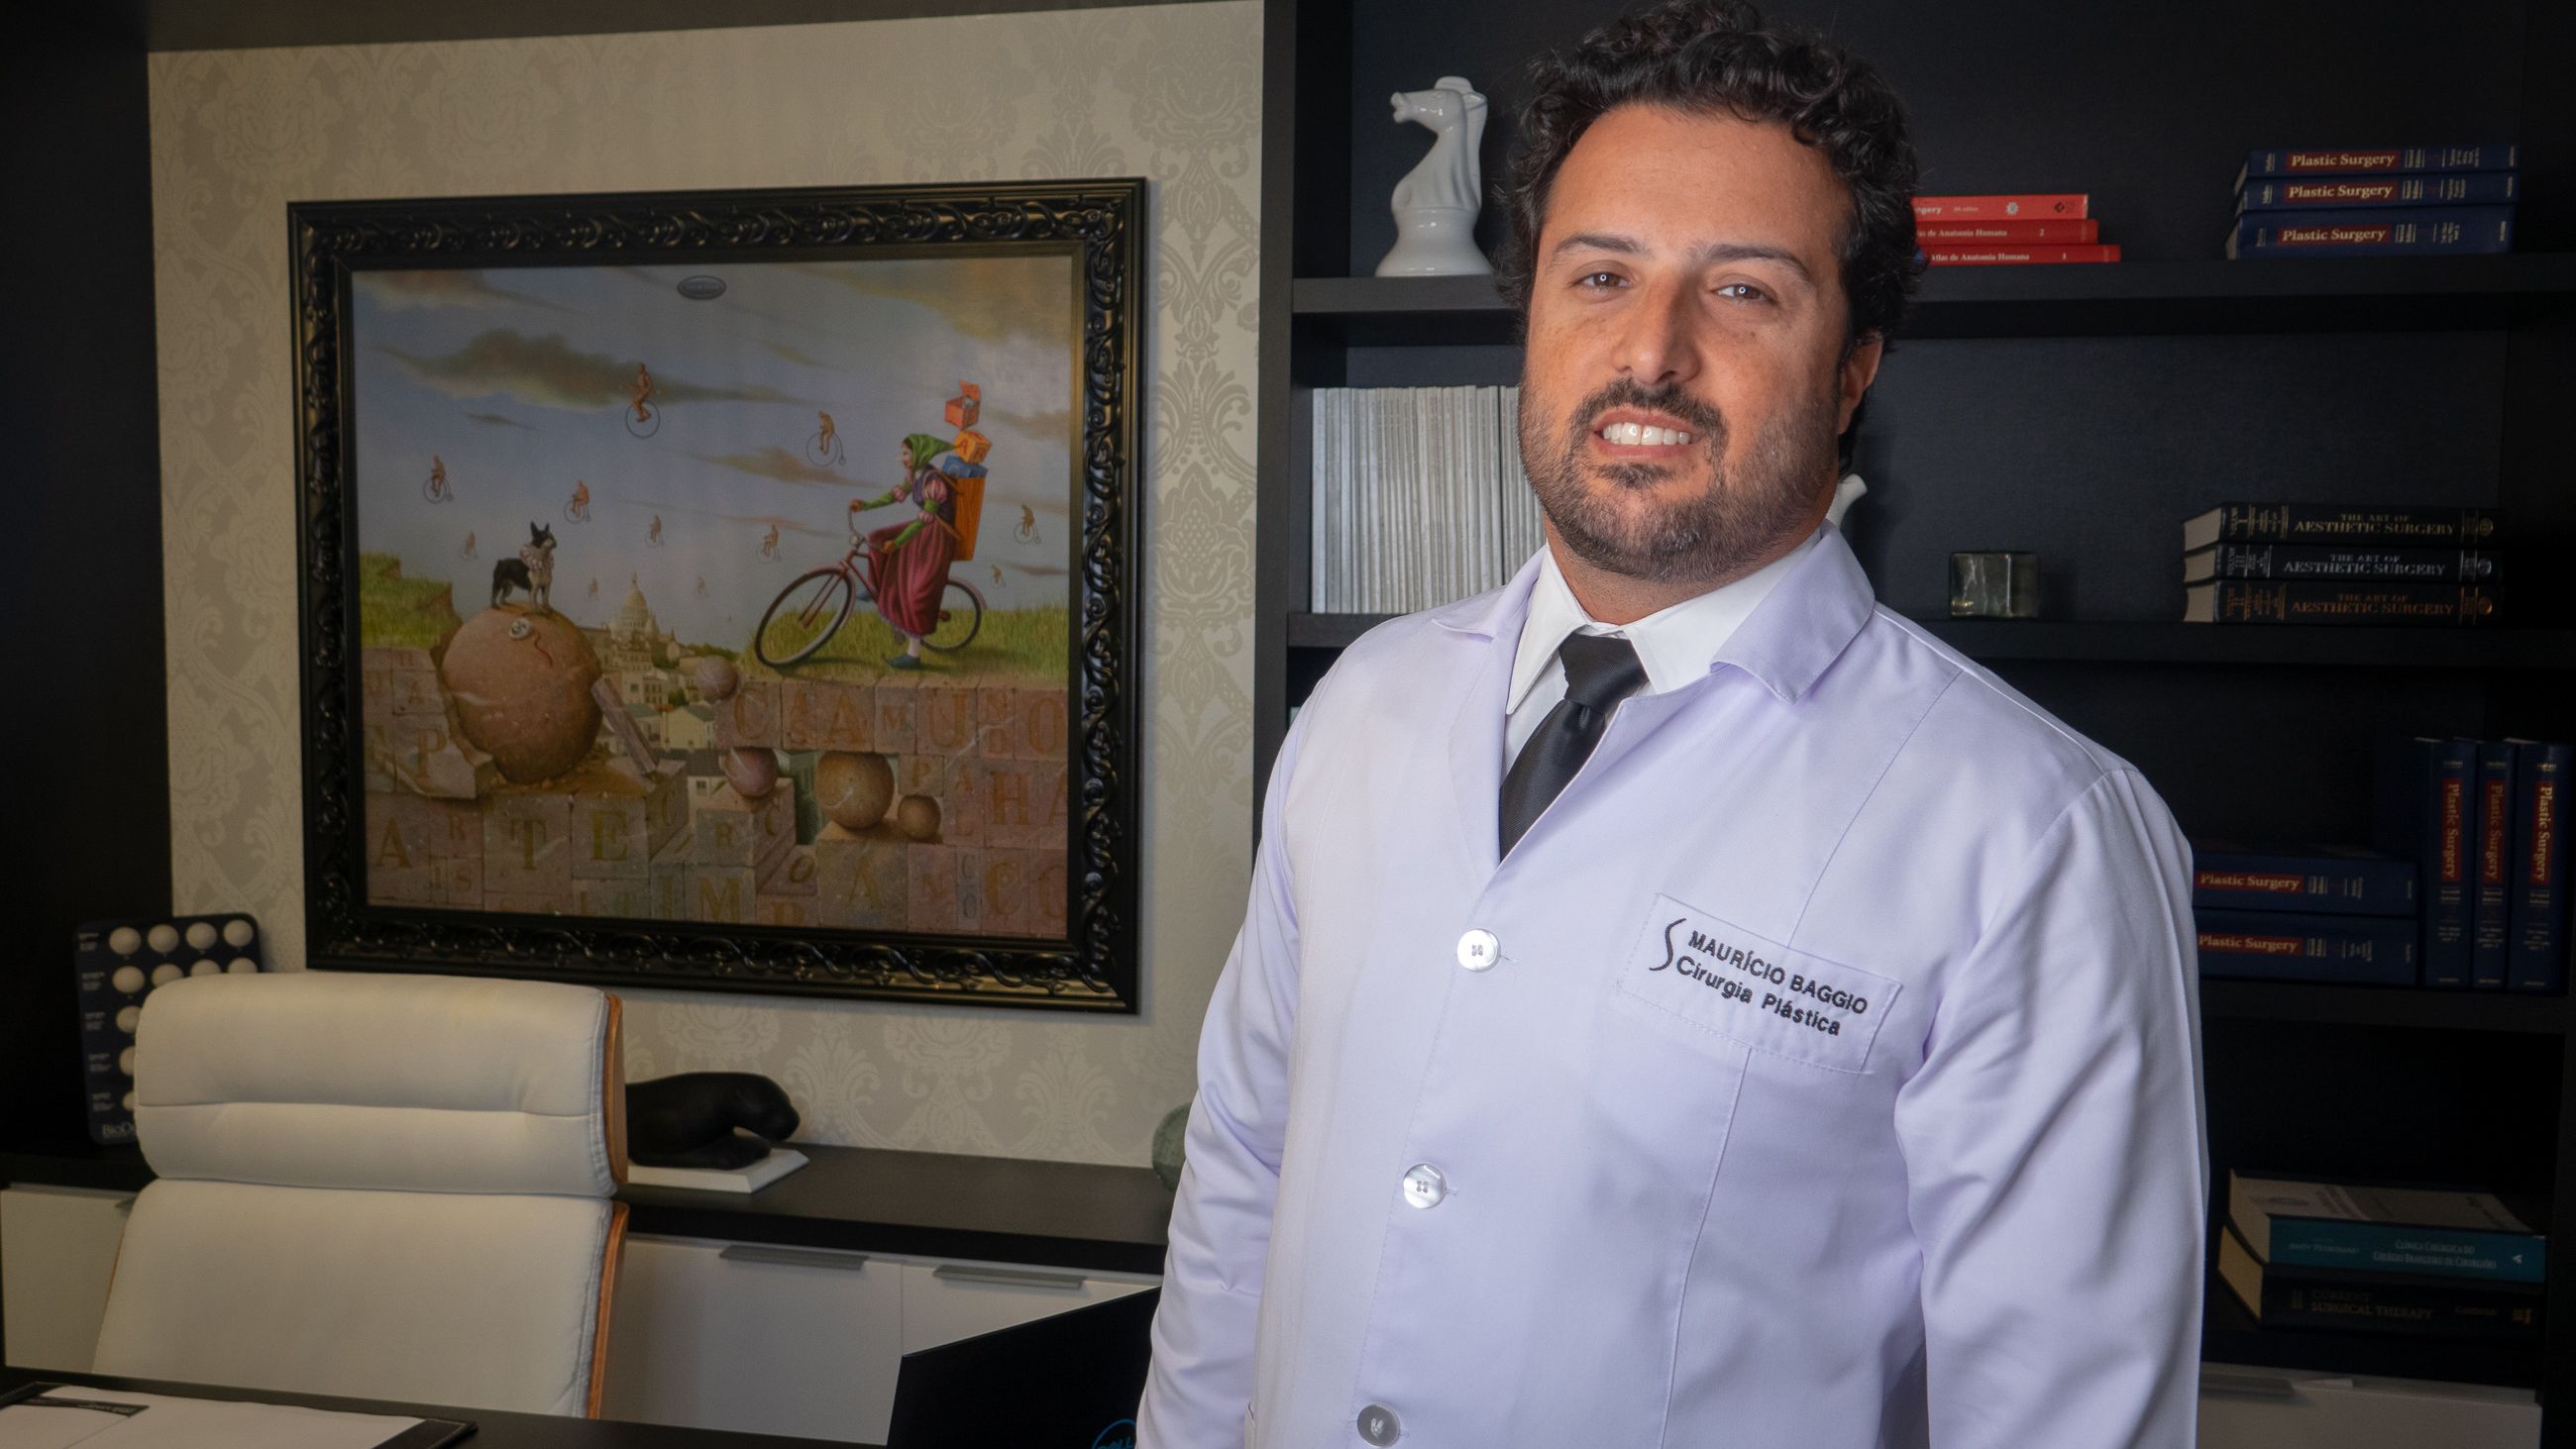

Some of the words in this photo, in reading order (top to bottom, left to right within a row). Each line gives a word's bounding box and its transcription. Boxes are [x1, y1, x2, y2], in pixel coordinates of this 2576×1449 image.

[2291, 154, 2337, 167] Plastic
[2339, 153, 2396, 167] Surgery
[2288, 185, 2335, 198] Plastic
[2337, 184, 2394, 198] Surgery
[2039, 228, 2045, 237] 2
[2282, 229, 2329, 242] Plastic
[2330, 228, 2387, 242] Surgery
[2340, 513, 2366, 522] THE
[2369, 513, 2391, 522] ART
[2295, 520, 2383, 534] AESTHETIC
[2385, 522, 2457, 536] SURGERY
[2329, 554, 2354, 563] THE
[2357, 554, 2380, 563] ART
[2384, 554, 2402, 564] OF
[2283, 561, 2374, 573] AESTHETIC
[2376, 563, 2446, 575] SURGERY
[2365, 593, 2387, 602] ART
[2292, 600, 2380, 613] AESTHETIC
[2383, 602, 2456, 615] SURGERY
[2446, 783, 2460, 823] Plastic
[2490, 783, 2504, 826] Plastic
[2537, 785, 2553, 827] Plastic
[2442, 827, 2459, 879] Surgery
[2484, 828, 2503, 880] Surgery
[2532, 830, 2550, 881] Surgery
[2200, 874, 2245, 886] Plastic
[2246, 876, 2300, 890] Surgery
[2199, 934, 2244, 947] Plastic
[2245, 937, 2299, 953] Surgery
[1688, 930, 1786, 985] MAURÍCIO
[1789, 974, 1869, 1015] BAGGIO
[1676, 955, 1754, 1004] Cirurgia
[1762, 992, 1842, 1037] Plástica
[2376, 1304, 2433, 1319] THERAPY
